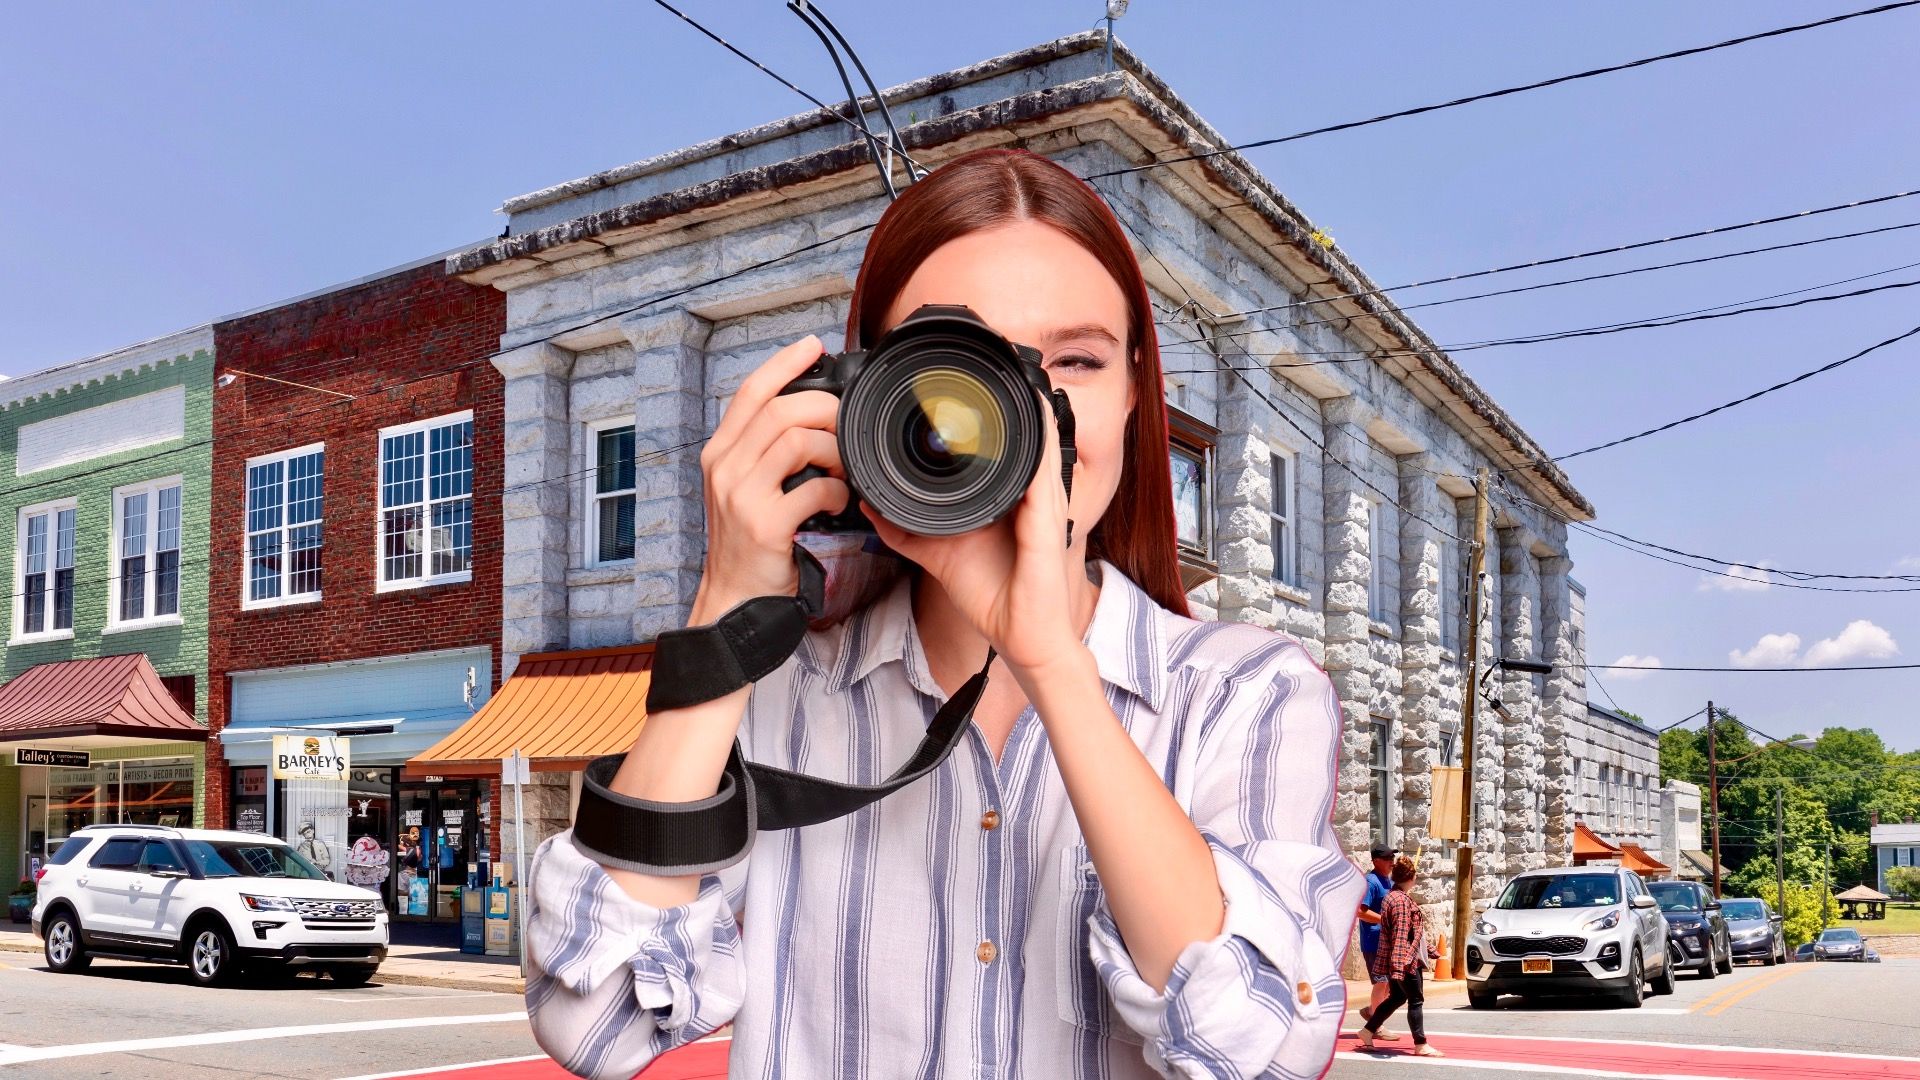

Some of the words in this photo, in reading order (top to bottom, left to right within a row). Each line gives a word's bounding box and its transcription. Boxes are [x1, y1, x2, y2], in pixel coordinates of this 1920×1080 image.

[20, 750, 55, 764] Talley's
[279, 754, 345, 771] BARNEY'S
[123, 770, 147, 781] ARTISTS
[153, 768, 173, 779] DECOR
[174, 767, 194, 778] PRINT
